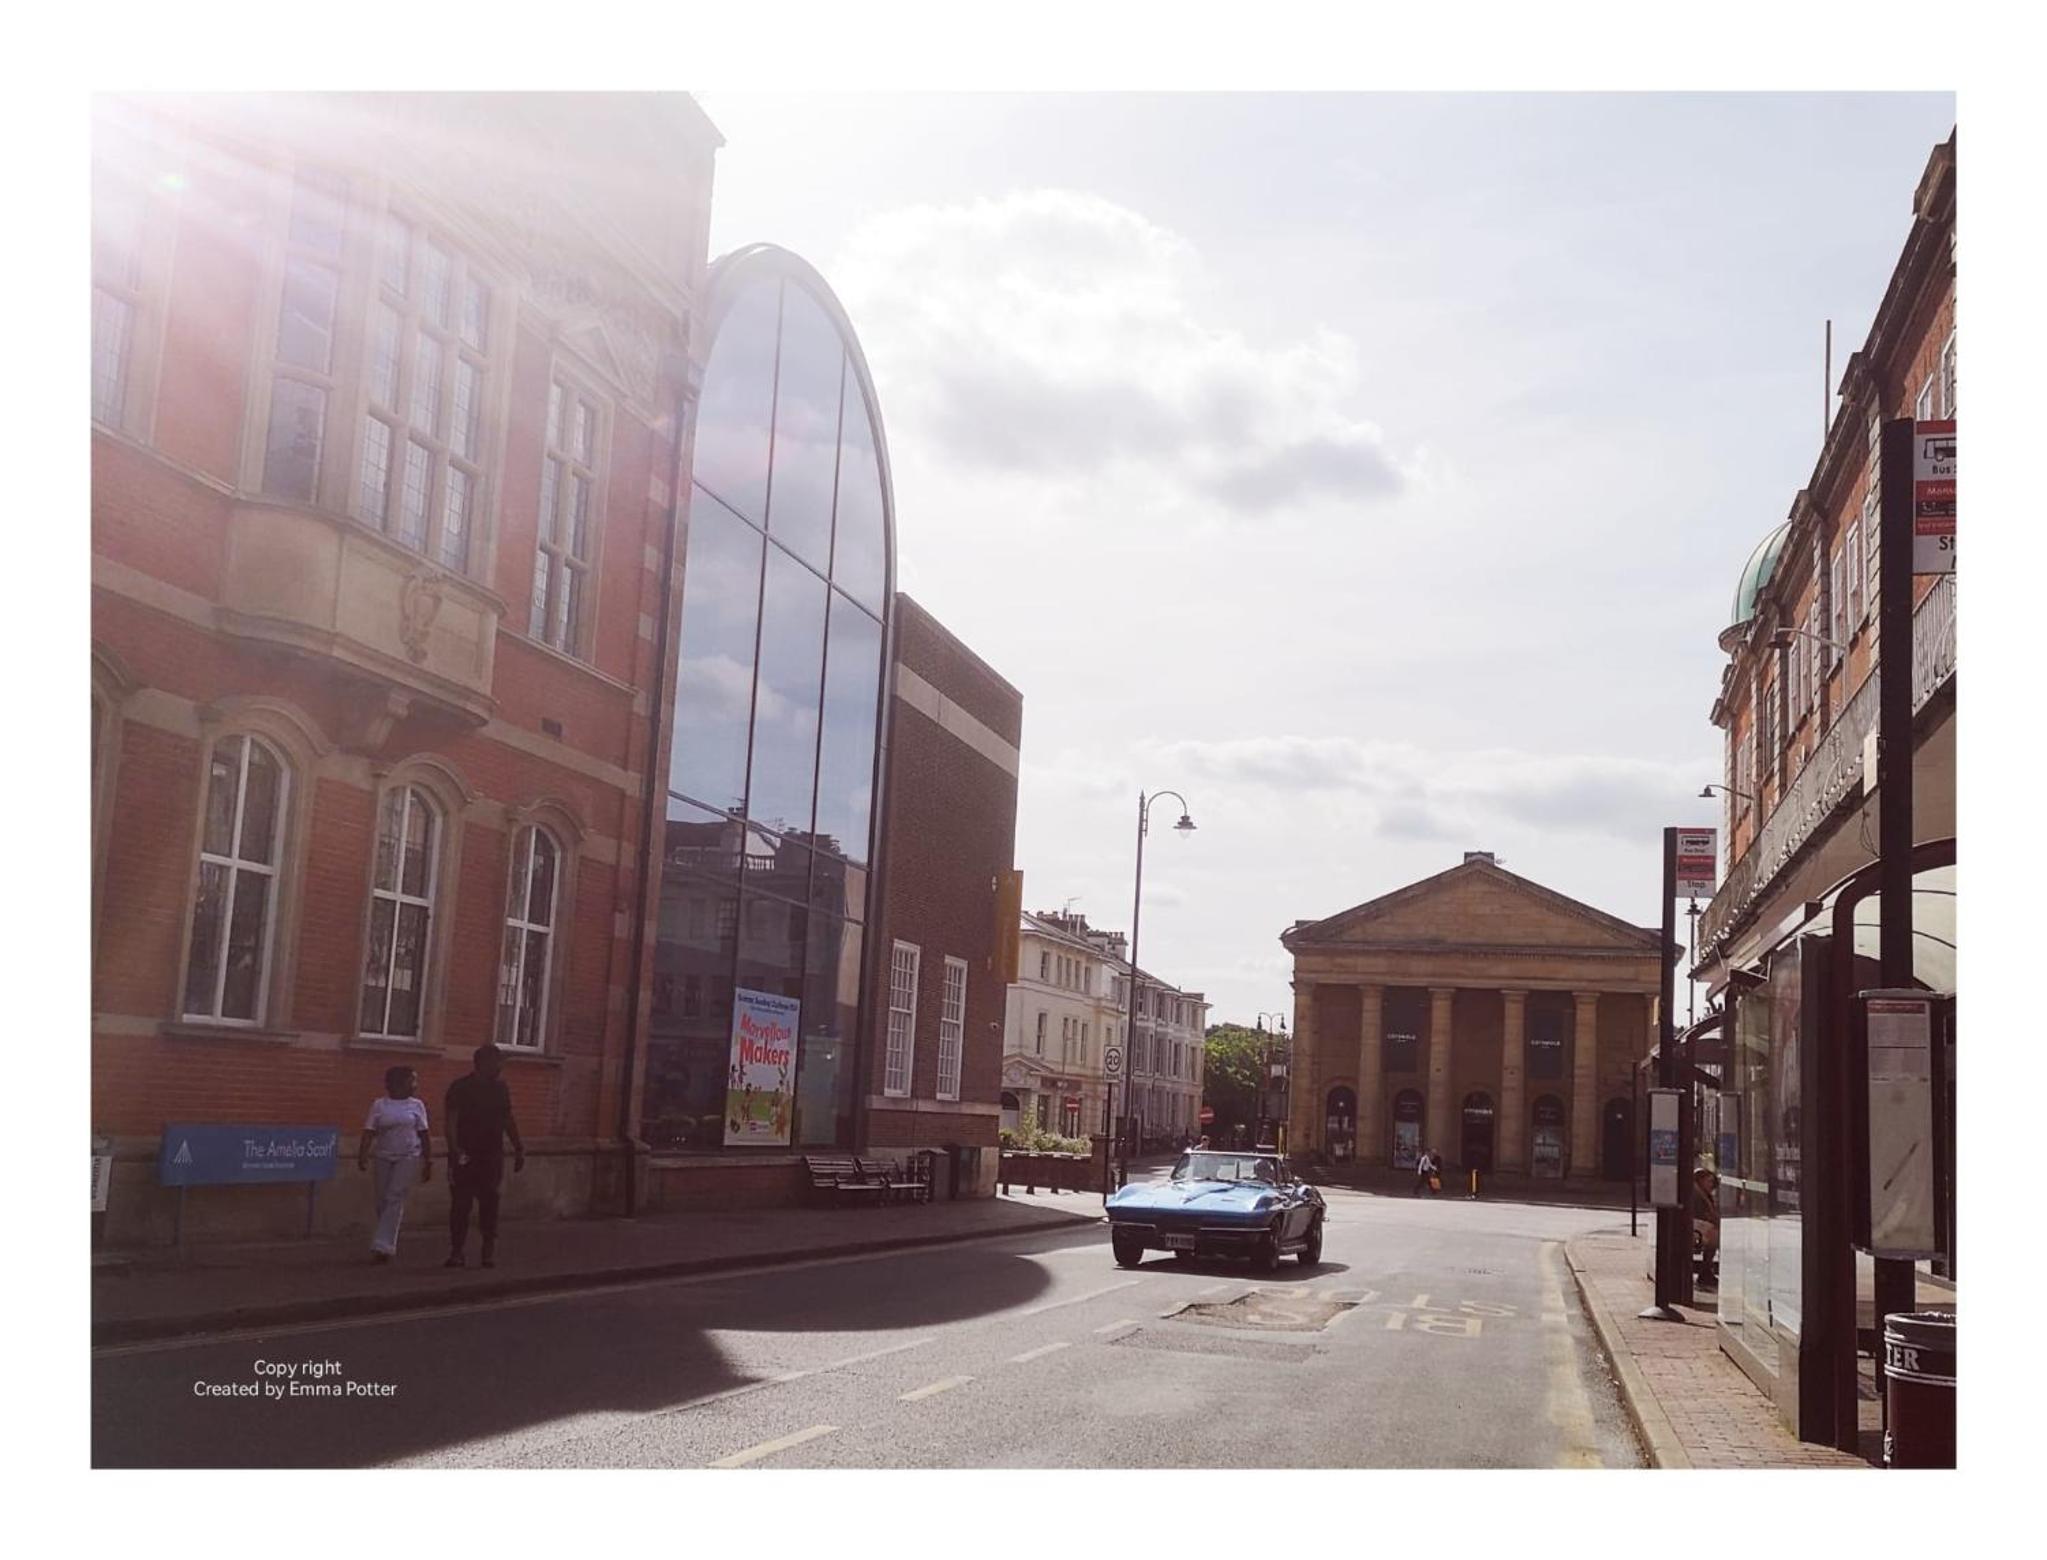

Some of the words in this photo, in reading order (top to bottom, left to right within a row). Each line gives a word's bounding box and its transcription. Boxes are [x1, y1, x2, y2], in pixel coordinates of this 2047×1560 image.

[739, 1036, 791, 1067] Makers
[1107, 1055, 1120, 1066] 20
[243, 1140, 265, 1157] The
[266, 1139, 305, 1158] Amelia
